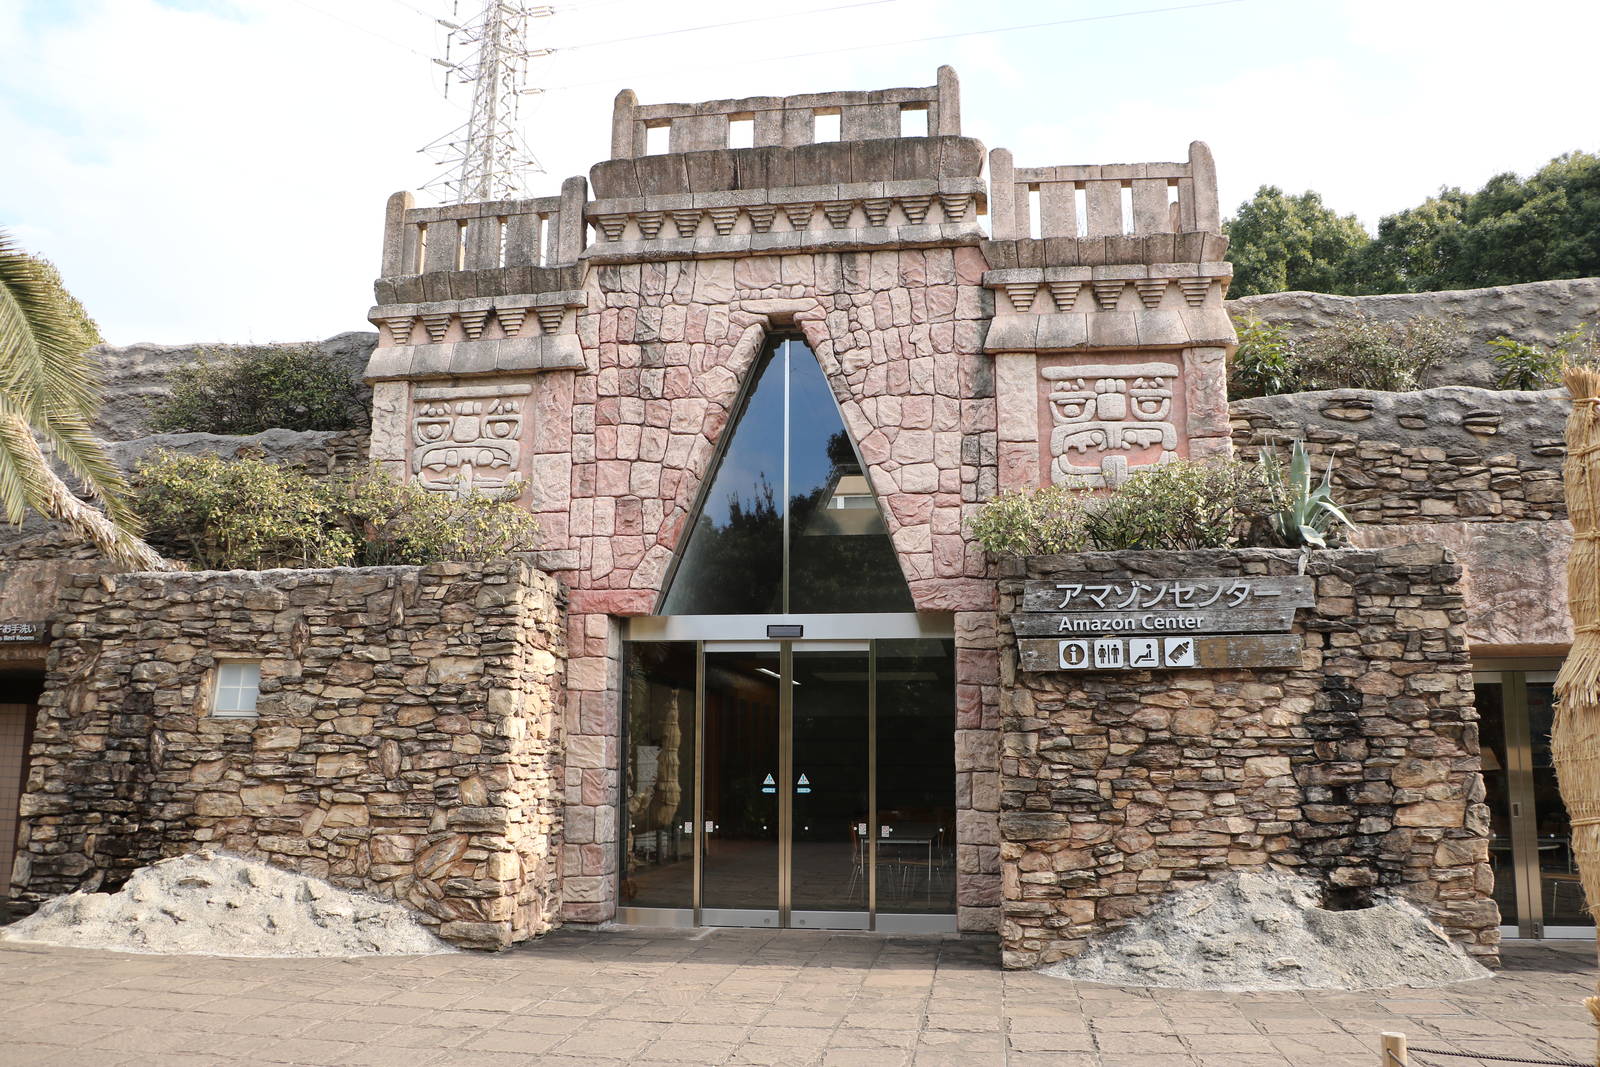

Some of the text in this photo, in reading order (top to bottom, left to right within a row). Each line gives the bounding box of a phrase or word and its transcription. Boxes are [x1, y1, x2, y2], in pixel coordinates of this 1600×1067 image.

[1056, 580, 1282, 609] アマゾンセンター
[1059, 614, 1204, 632] Amazon Center
